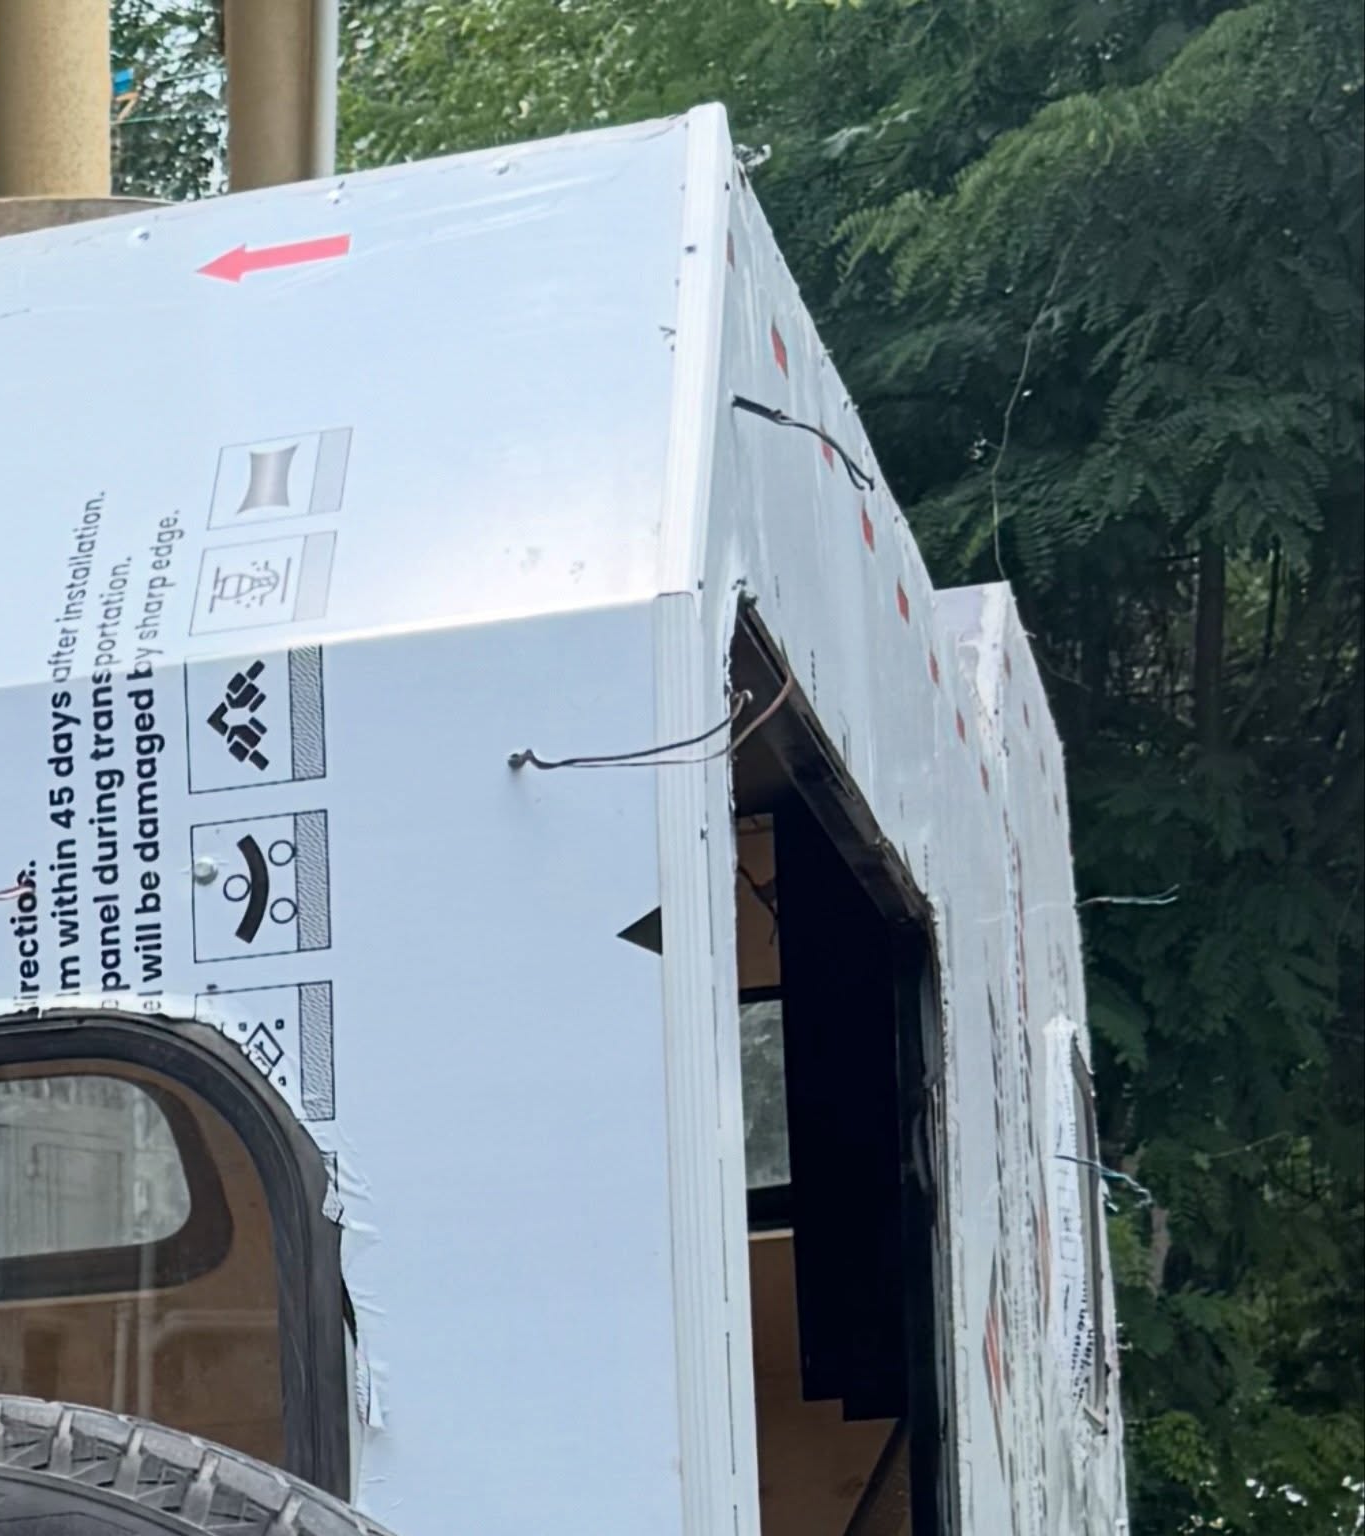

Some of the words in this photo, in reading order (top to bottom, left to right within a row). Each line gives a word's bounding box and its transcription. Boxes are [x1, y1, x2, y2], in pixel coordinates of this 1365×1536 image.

[55, 490, 106, 622] installation.
[149, 508, 184, 570] edge.
[134, 575, 174, 640] sharp
[50, 627, 82, 683] after
[88, 555, 133, 761] transportation.
[126, 647, 163, 679] by
[46, 691, 83, 778] days
[49, 786, 76, 829] 45
[127, 688, 165, 863] damaged
[88, 769, 124, 885] during
[50, 839, 80, 947] within
[132, 872, 161, 913] be
[93, 895, 129, 992] panel
[134, 923, 163, 982] will
